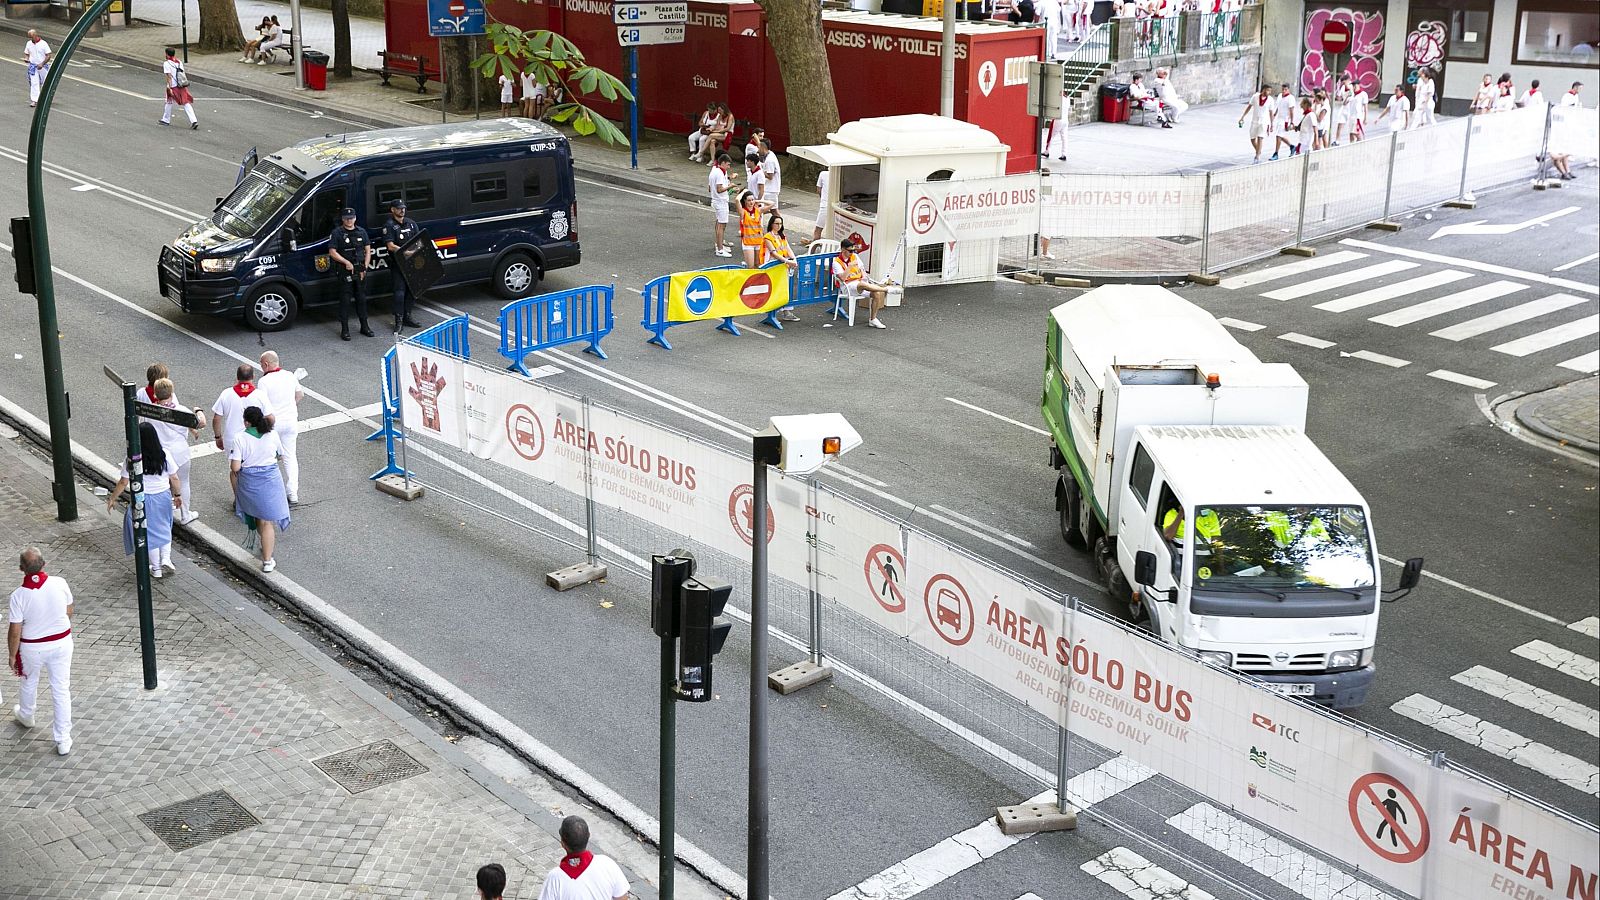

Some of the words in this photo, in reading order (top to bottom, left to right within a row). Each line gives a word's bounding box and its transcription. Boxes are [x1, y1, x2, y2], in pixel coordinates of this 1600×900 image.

[566, 0, 611, 15] KOMUNAK
[827, 30, 866, 48] ASEOS
[871, 34, 893, 51] WC
[692, 74, 718, 88] Balat
[943, 192, 974, 211] ÁREA
[977, 188, 1008, 208] SÓLO
[1011, 188, 1036, 205] BUS
[476, 384, 486, 396] TCC
[553, 412, 600, 455] ÁREA
[604, 435, 651, 473] SÓLO
[657, 454, 697, 490] BUS
[554, 446, 627, 480] AUTOBUSENDAKO
[629, 473, 665, 496] EREMUA
[576, 470, 599, 487] AREA
[601, 478, 618, 493] FOR
[620, 484, 647, 505] BUSES
[649, 497, 672, 513] ONLY
[822, 511, 836, 526] TCC
[986, 594, 1049, 657] ÁREA
[1055, 636, 1124, 691] SÓLO
[1133, 669, 1194, 723] BUS
[986, 633, 1086, 695] AUTOBUSENDAKO
[1088, 686, 1142, 722] EREMUA
[1145, 710, 1190, 744] SOILIK
[1015, 669, 1044, 696] AREA
[1046, 686, 1069, 709] FOR
[1070, 699, 1113, 729] BUSES
[1116, 720, 1152, 746] ONLY
[1279, 723, 1300, 743] TCC
[1449, 806, 1554, 891] ÁREA
[1566, 863, 1599, 900] N
